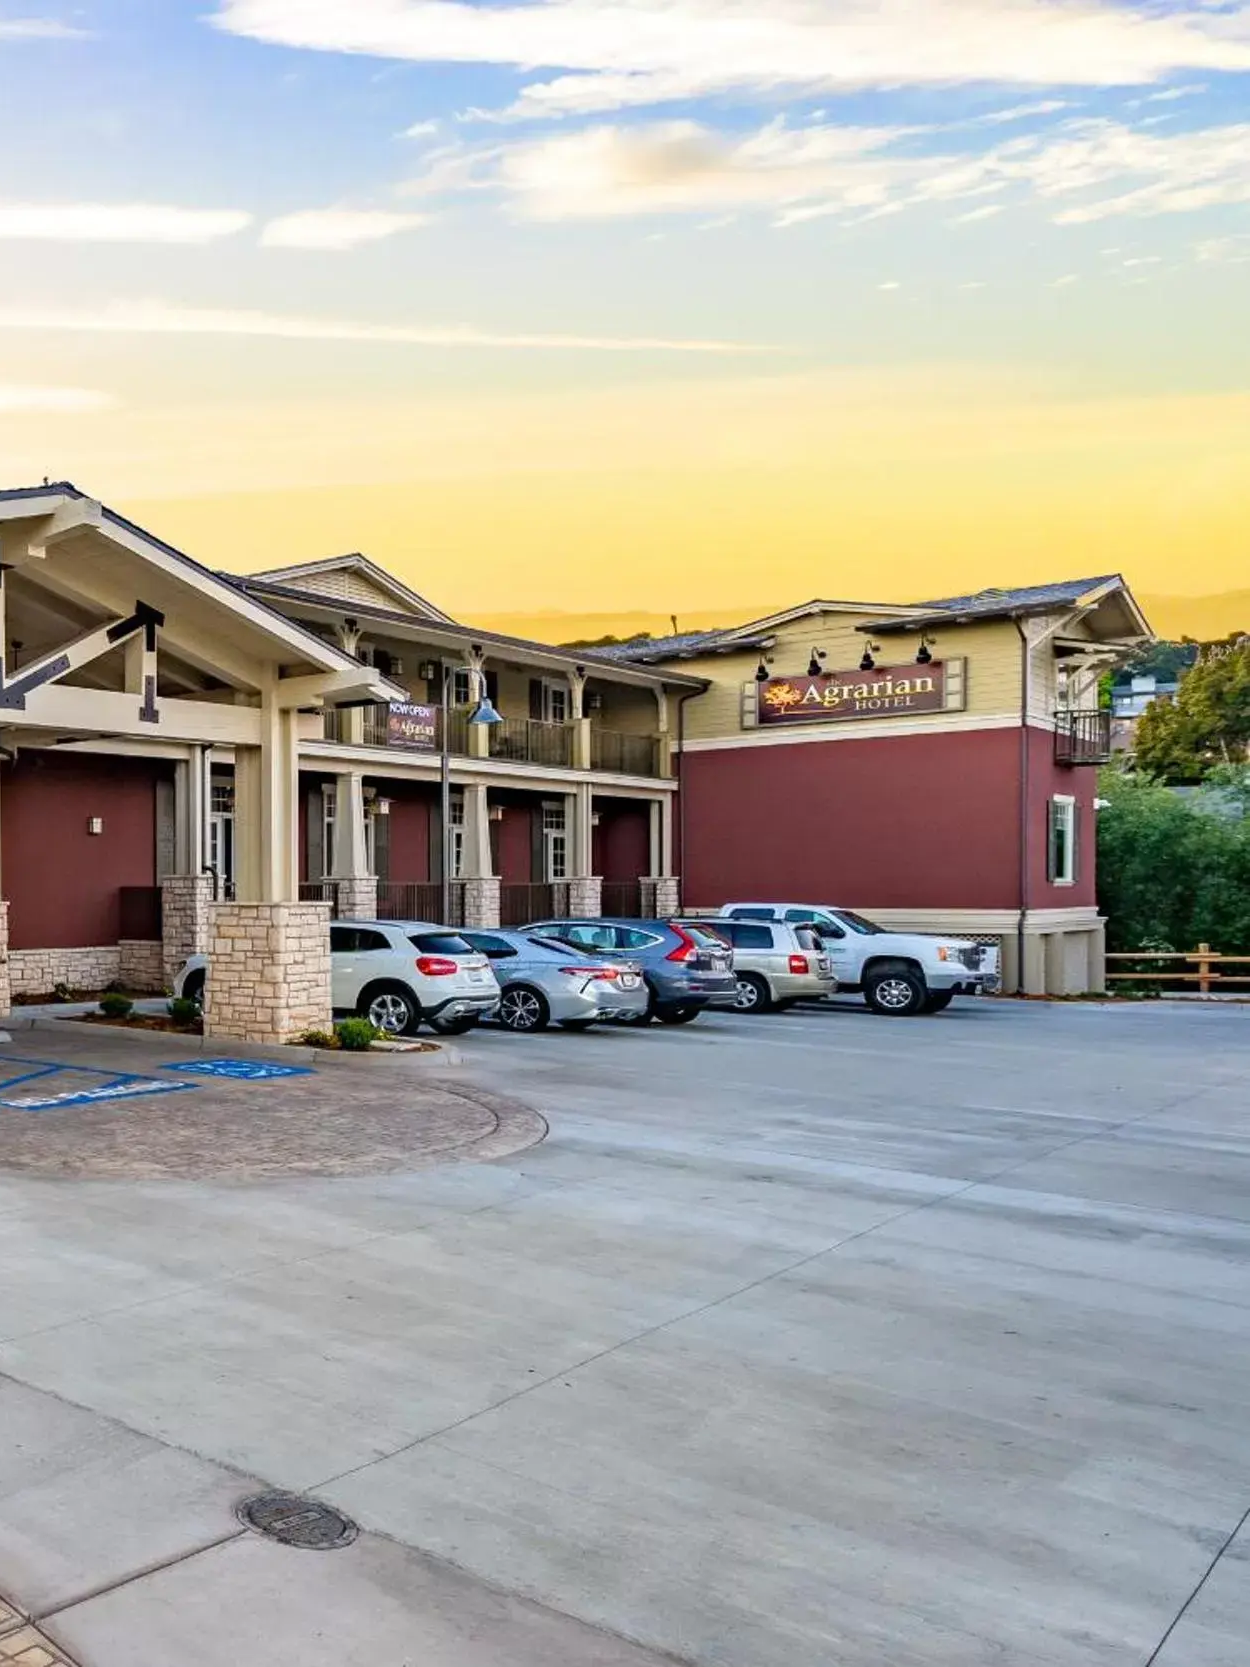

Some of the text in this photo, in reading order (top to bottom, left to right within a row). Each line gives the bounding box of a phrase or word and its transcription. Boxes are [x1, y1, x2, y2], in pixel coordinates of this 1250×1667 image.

[801, 675, 935, 708] Agrarian
[390, 703, 431, 717] NOW OPEN
[855, 697, 916, 711] HOTEL
